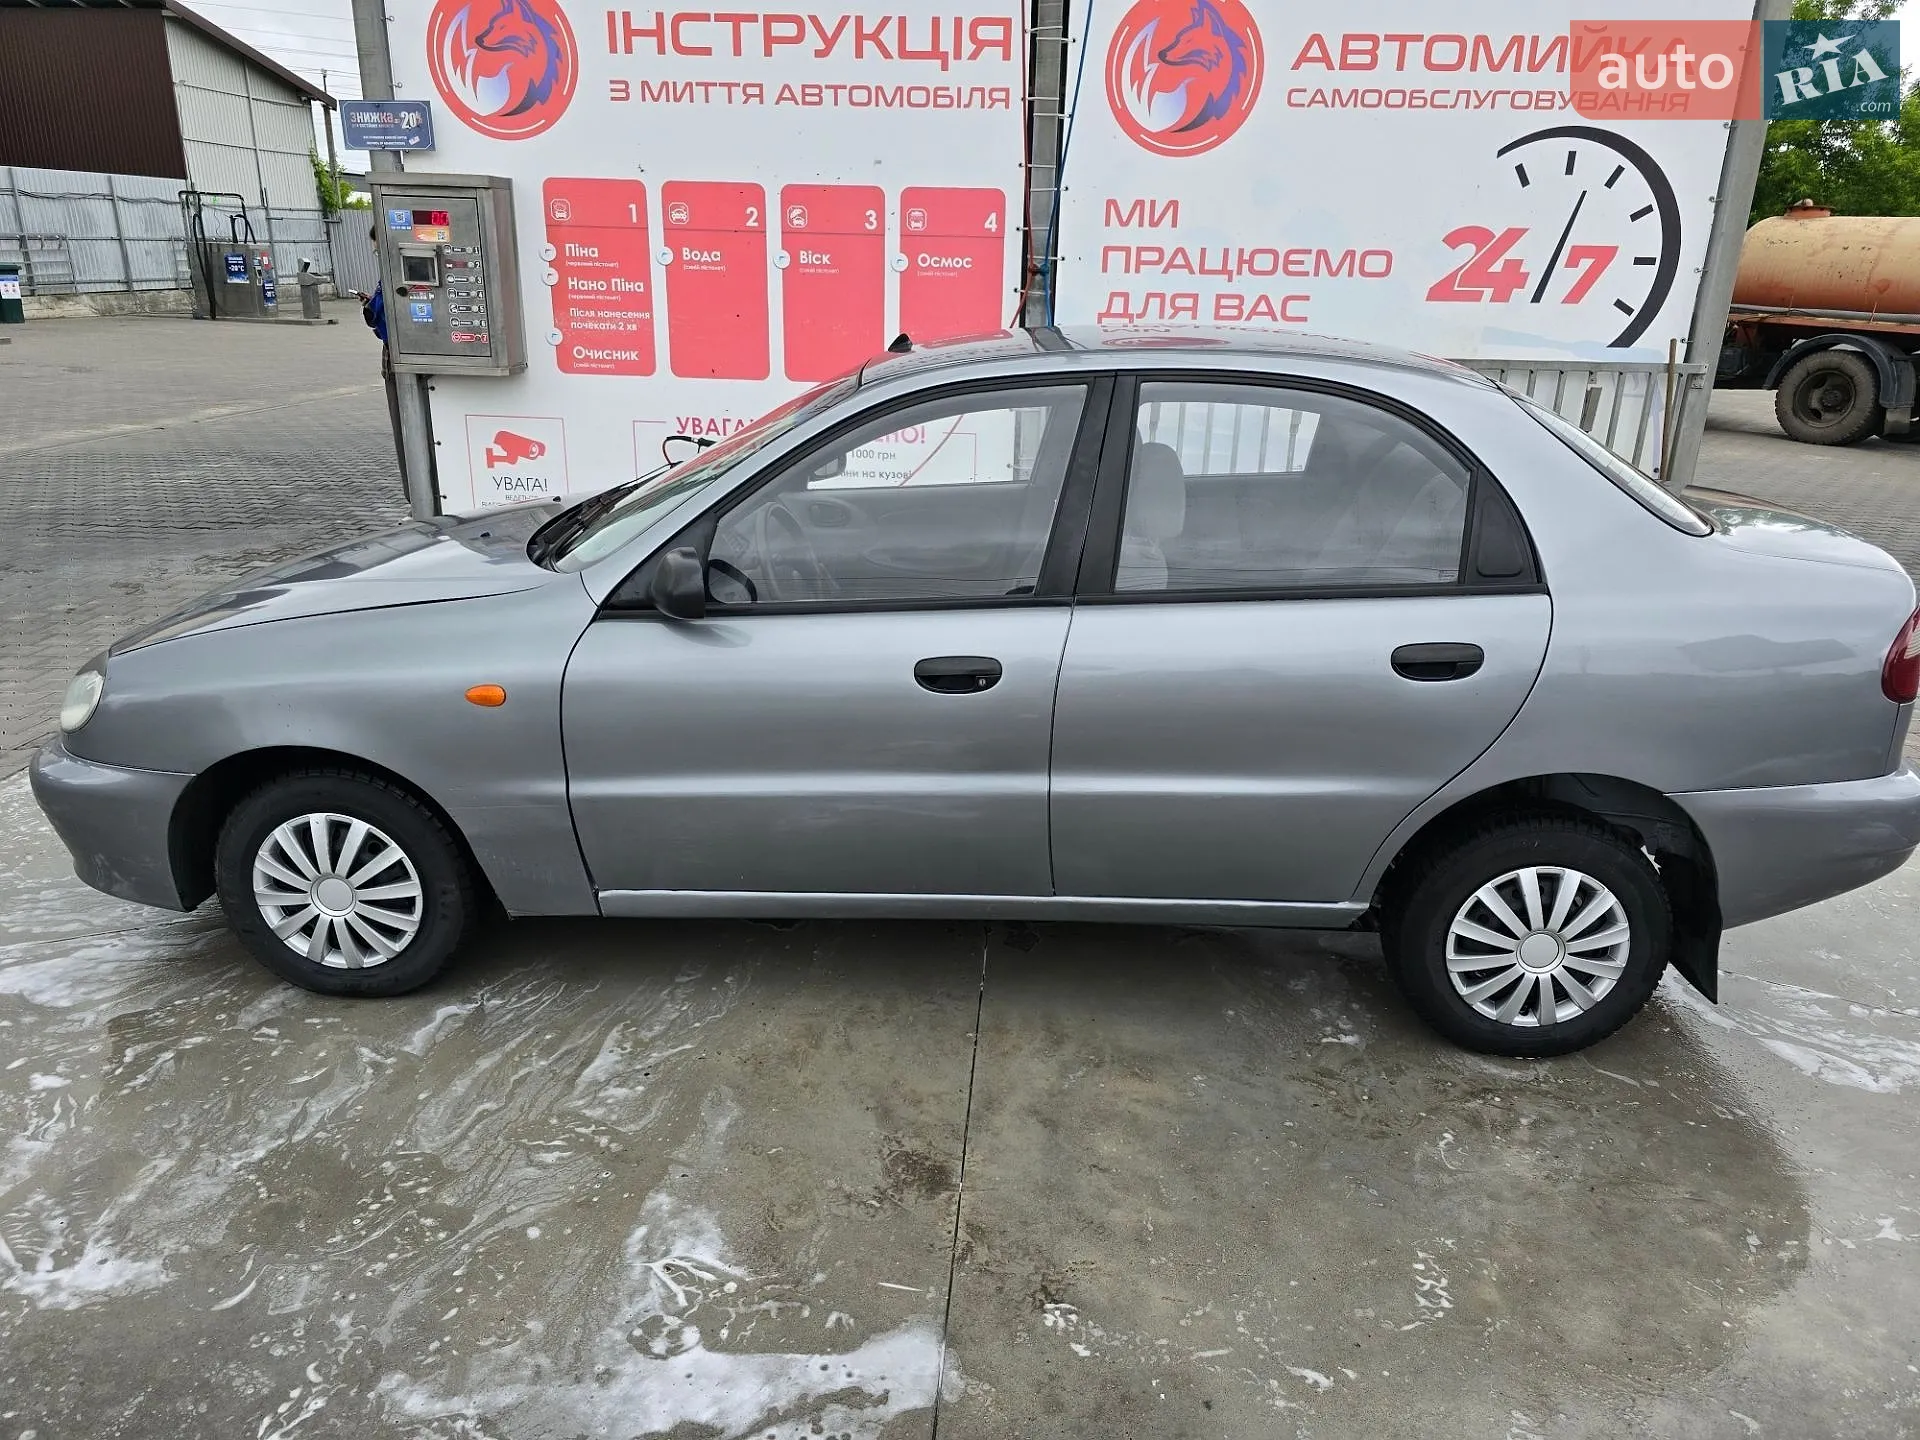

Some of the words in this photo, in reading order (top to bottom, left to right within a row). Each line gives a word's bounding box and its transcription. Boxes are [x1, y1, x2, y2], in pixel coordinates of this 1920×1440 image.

[607, 11, 1013, 71] ІНСТРУКЦІЯ
[609, 80, 631, 102] З
[640, 80, 764, 105] МИТТЯ
[775, 83, 1011, 110] АВТОМОБІЛЯ
[1286, 87, 1691, 112] САМООБСЛУГОВУВАННЯ
[628, 203, 638, 224] 1
[745, 206, 760, 227] 2
[864, 209, 878, 230] 3
[984, 211, 998, 233] 4
[1104, 198, 1180, 229] МИ
[565, 243, 599, 258] Піна
[682, 247, 721, 262] Вода
[800, 251, 831, 265] Віск
[917, 252, 973, 268] Осмос
[1425, 195, 1620, 305] 24/7
[1101, 246, 1394, 283] ПРАЦЮЄМО
[568, 277, 607, 291] Нано
[611, 278, 645, 293] Піна
[570, 307, 595, 318] Після
[597, 310, 651, 320] нанесення
[1097, 291, 1199, 324] ДЛЯ
[1213, 294, 1311, 322] ВАС
[570, 321, 617, 330] почекати
[618, 322, 625, 331] 2
[573, 346, 639, 361] Очисник
[492, 475, 548, 492] УВАГА!
